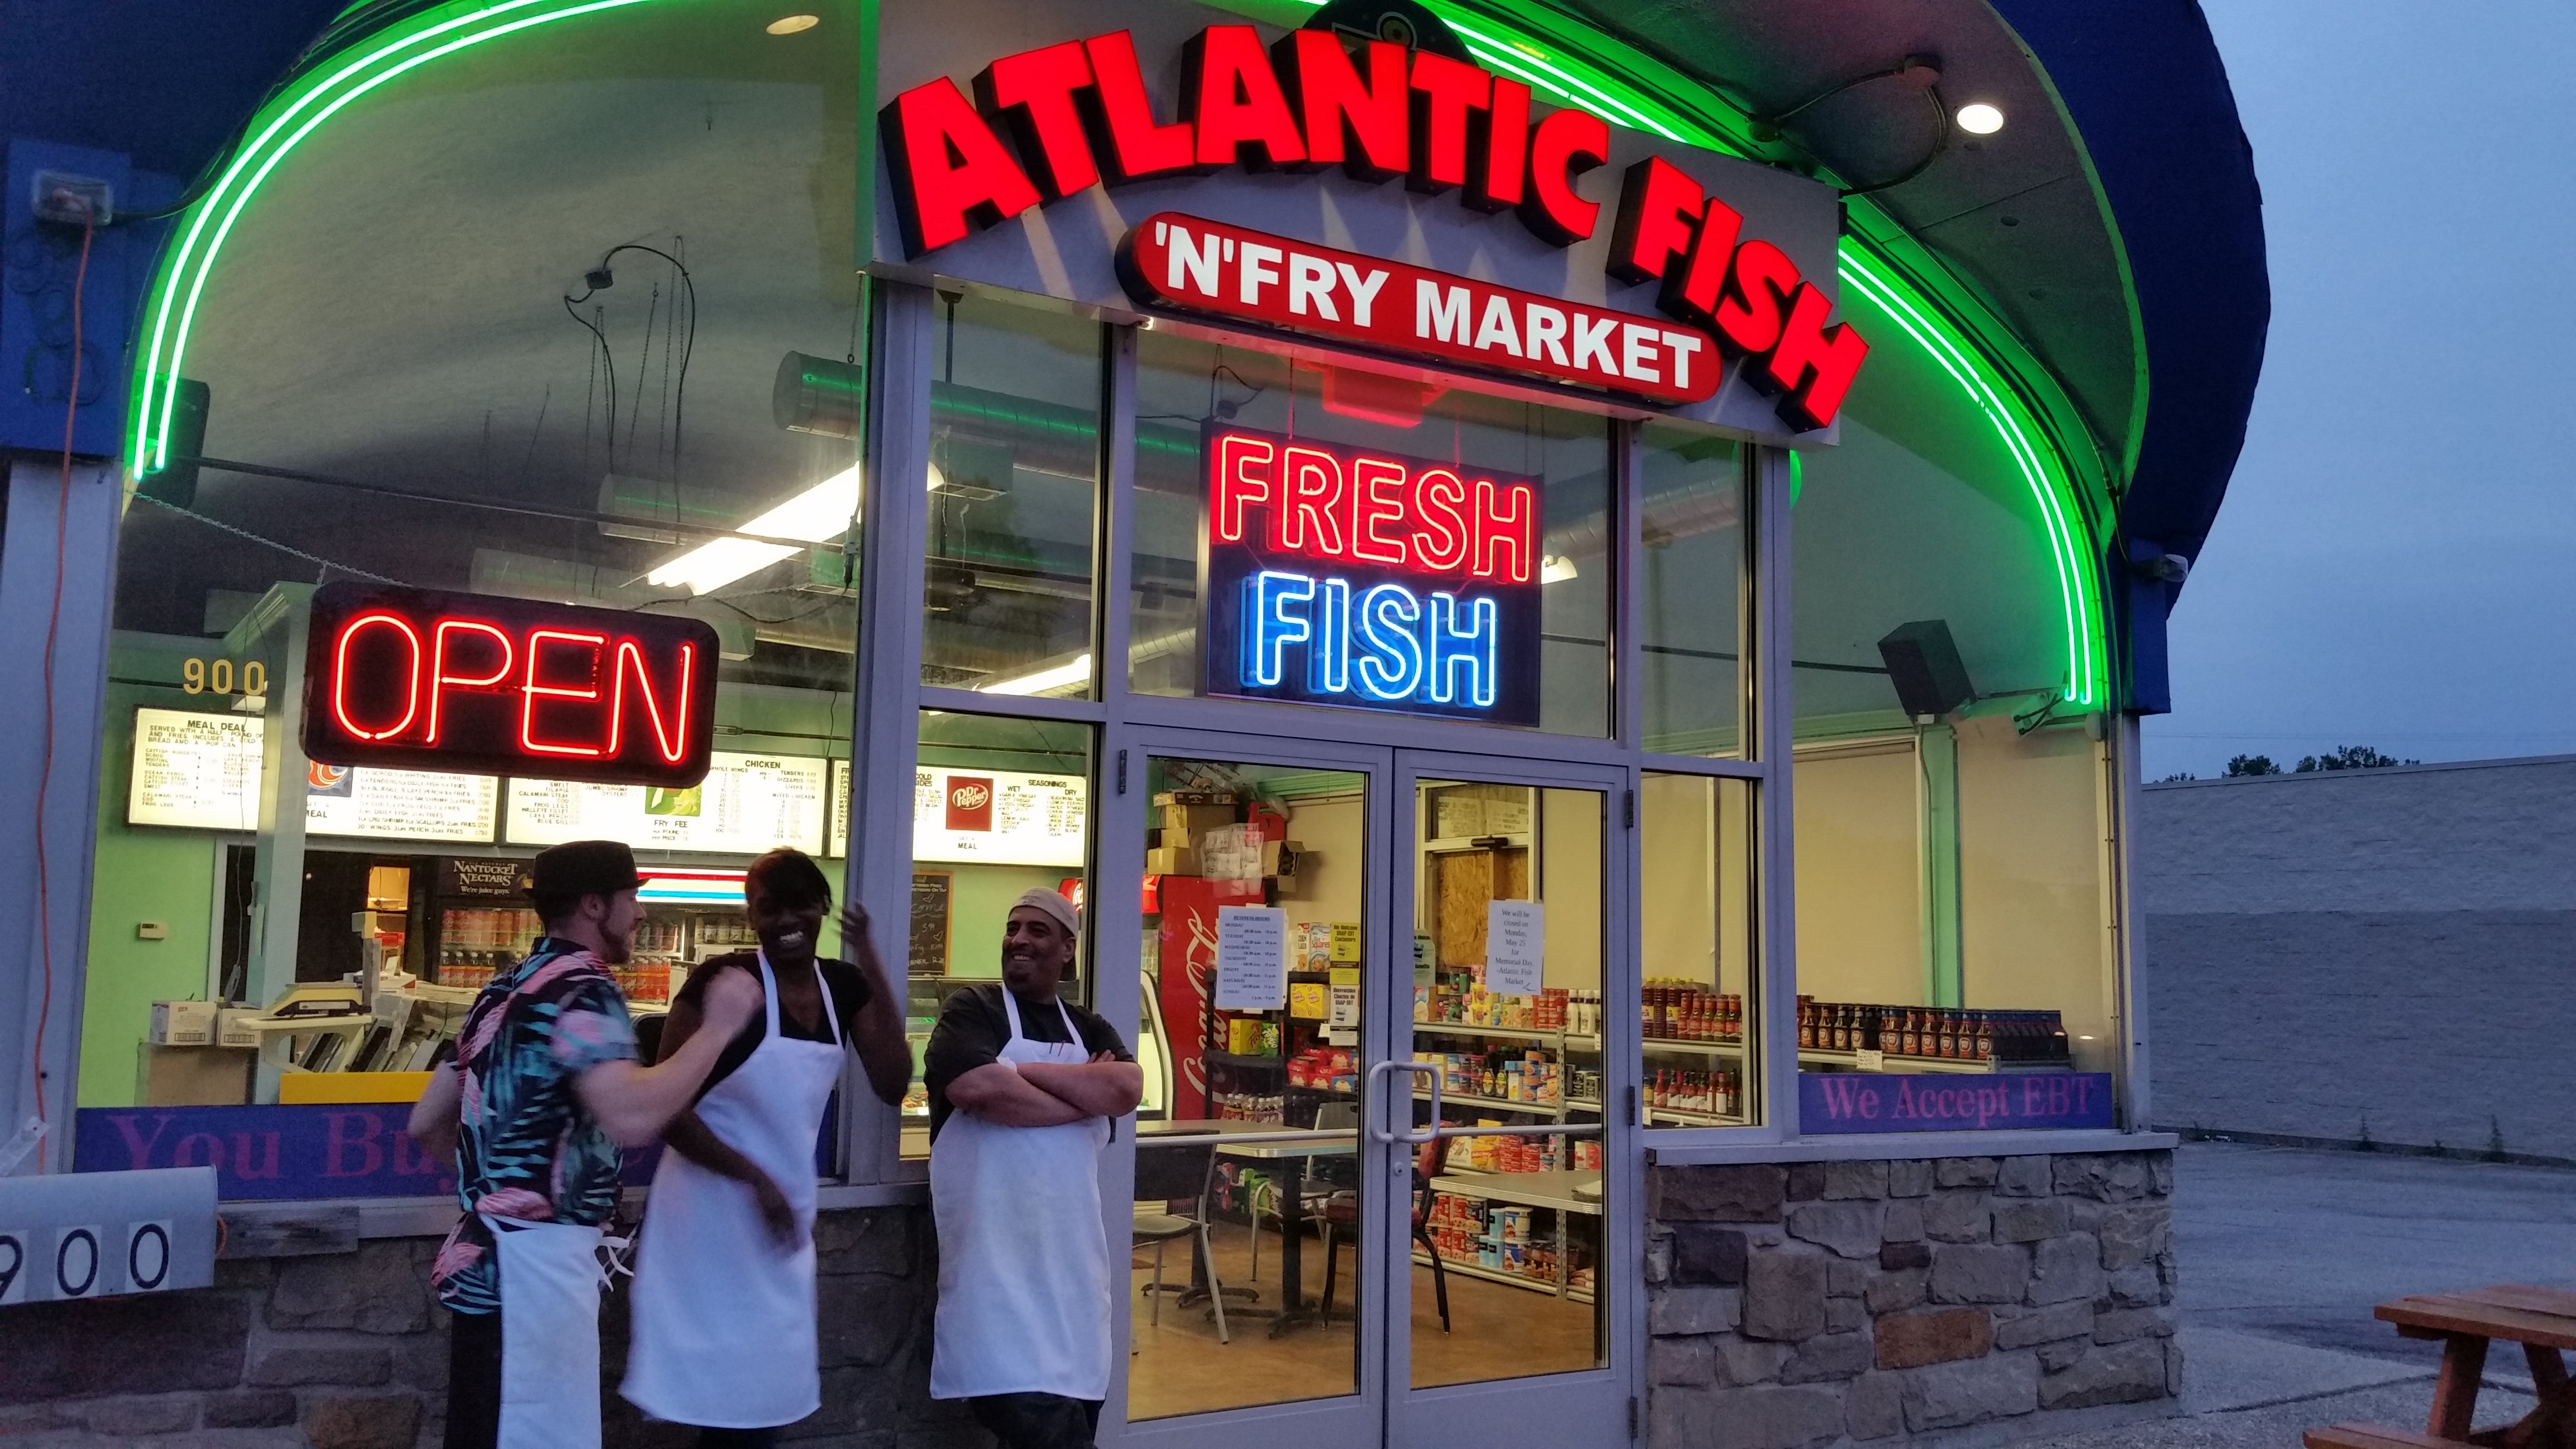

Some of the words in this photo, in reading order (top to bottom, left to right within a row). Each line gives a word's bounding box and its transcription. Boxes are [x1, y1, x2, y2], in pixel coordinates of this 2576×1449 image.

[899, 24, 1610, 251] ATLANTIC
[1632, 154, 1870, 431] FISH
[1415, 280, 1702, 390] MARKET
[1219, 434, 1531, 583] FRESH
[1255, 570, 1496, 707] FISH
[183, 658, 266, 696] 900
[335, 613, 692, 762] OPEN
[188, 720, 215, 729] MEAL
[745, 760, 781, 769] CHICKEN
[957, 788, 985, 807] Pepper
[966, 786, 979, 797] Dr
[453, 861, 518, 875] NANTUCKET
[459, 873, 511, 886] NECTARS
[1505, 929, 1527, 937] Monday,
[1312, 941, 1330, 950] Squares
[1506, 939, 1517, 947] May
[1820, 1077, 1879, 1120] We
[1891, 1074, 2009, 1128] Accept
[2023, 1076, 2094, 1115] EBT
[108, 1111, 283, 1180] You
[320, 1111, 454, 1191] Bu
